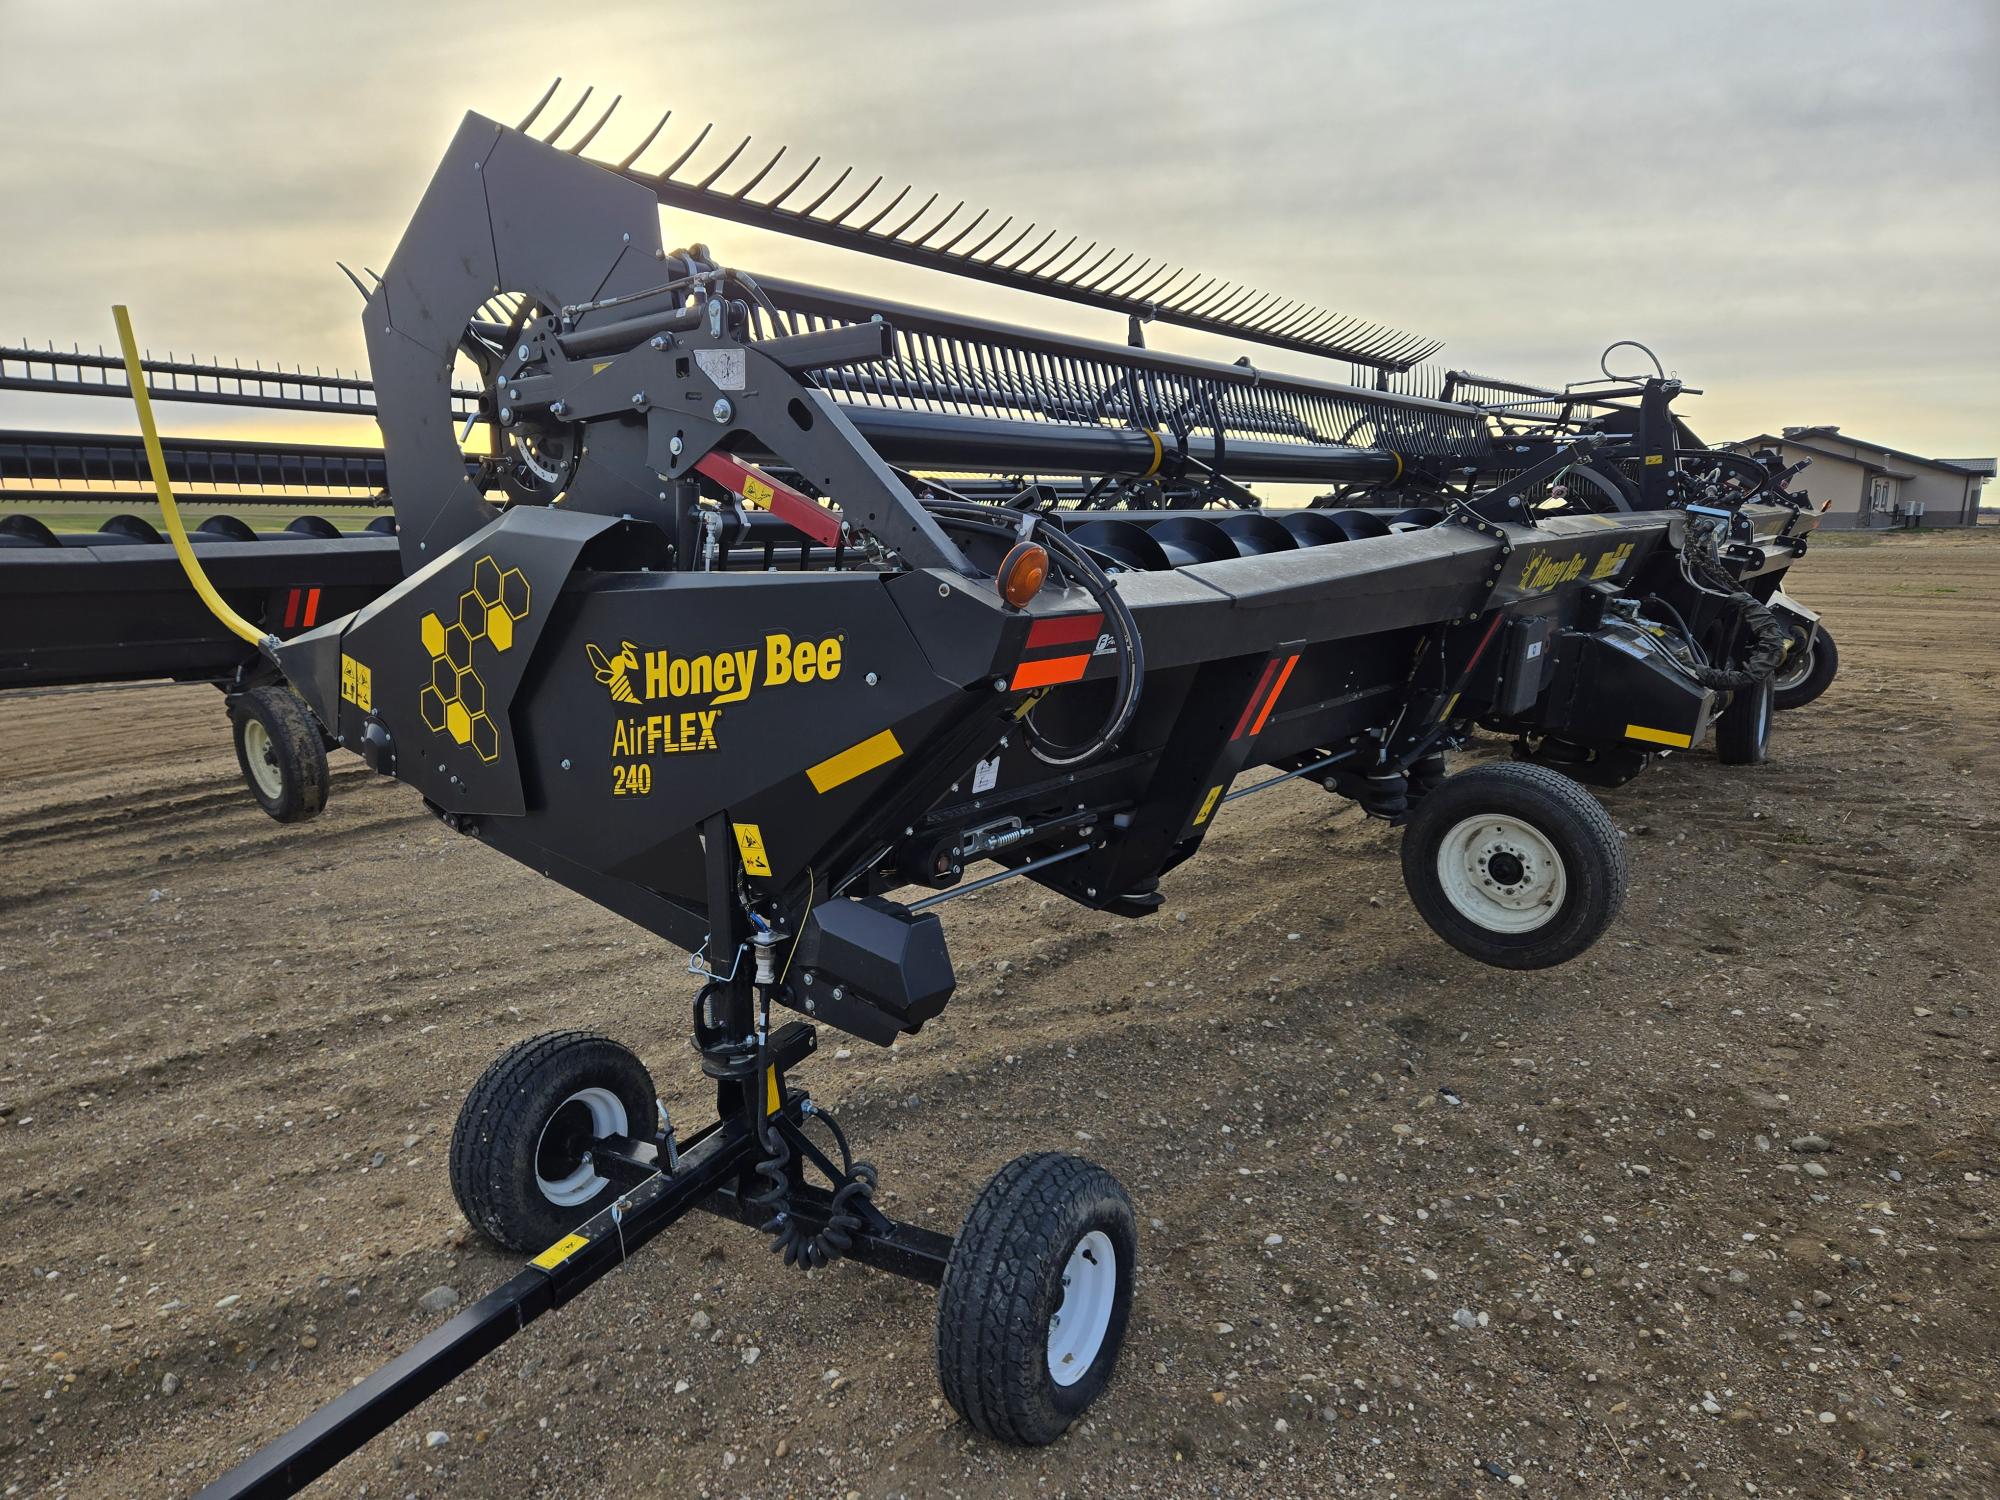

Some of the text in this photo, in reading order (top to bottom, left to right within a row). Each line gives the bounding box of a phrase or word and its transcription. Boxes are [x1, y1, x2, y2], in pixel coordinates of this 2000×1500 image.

[645, 633, 842, 705] Honey Bee
[613, 763, 651, 794] 240
